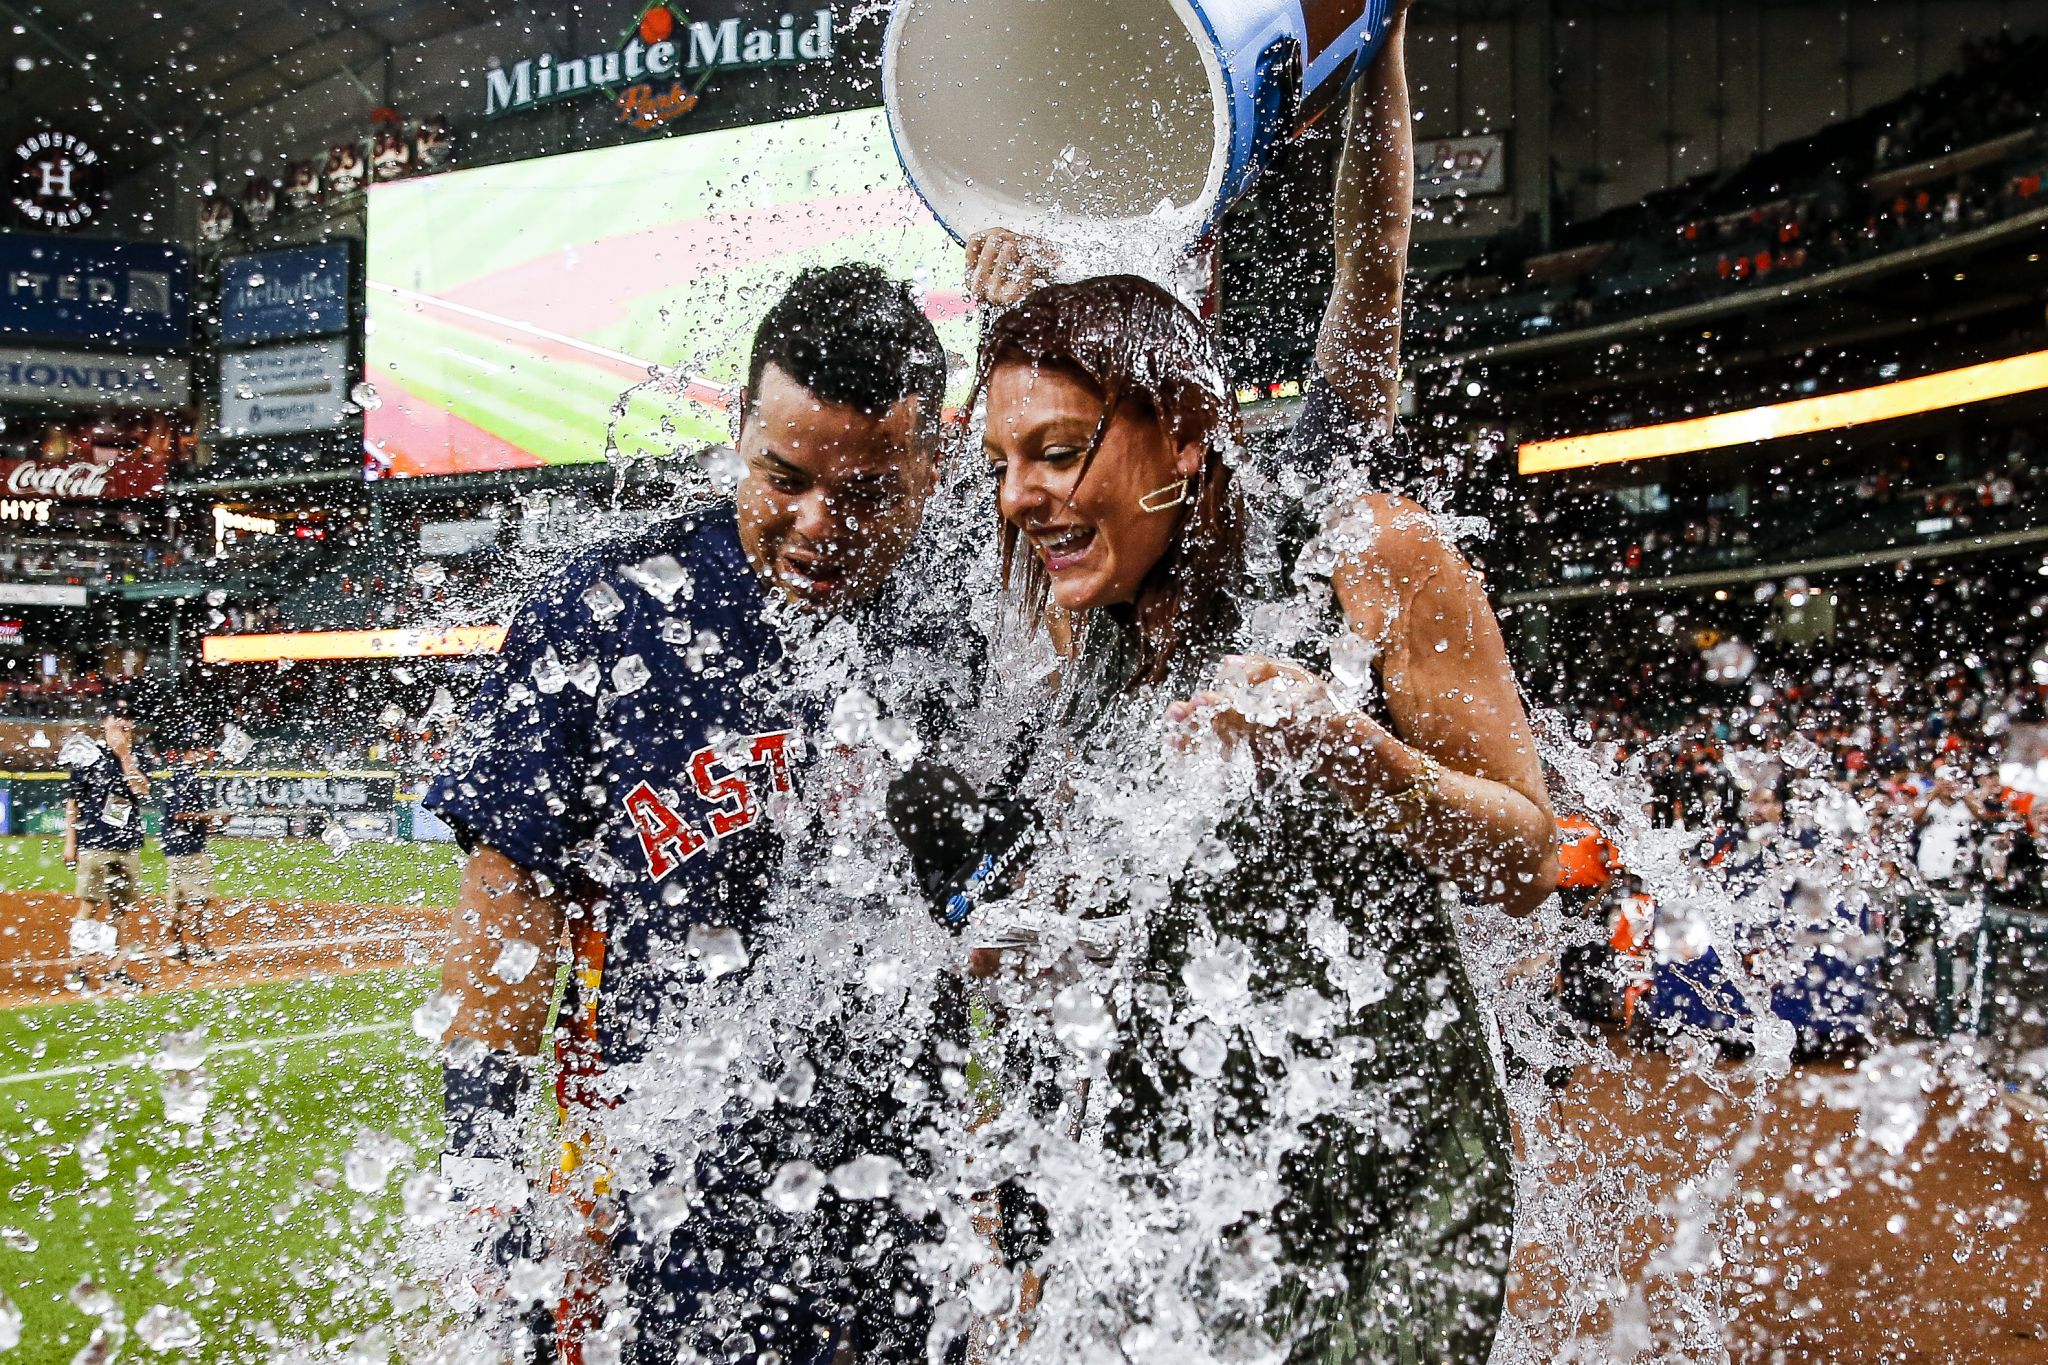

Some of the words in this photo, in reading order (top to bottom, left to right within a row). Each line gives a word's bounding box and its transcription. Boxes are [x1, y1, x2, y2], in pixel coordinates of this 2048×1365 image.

[484, 37, 678, 116] Minute
[687, 8, 834, 69] Maid
[16, 132, 98, 166] HOUSTON
[38, 160, 75, 197] H
[0, 363, 162, 394] HONDA
[971, 820, 1037, 908] SPORTSNET
